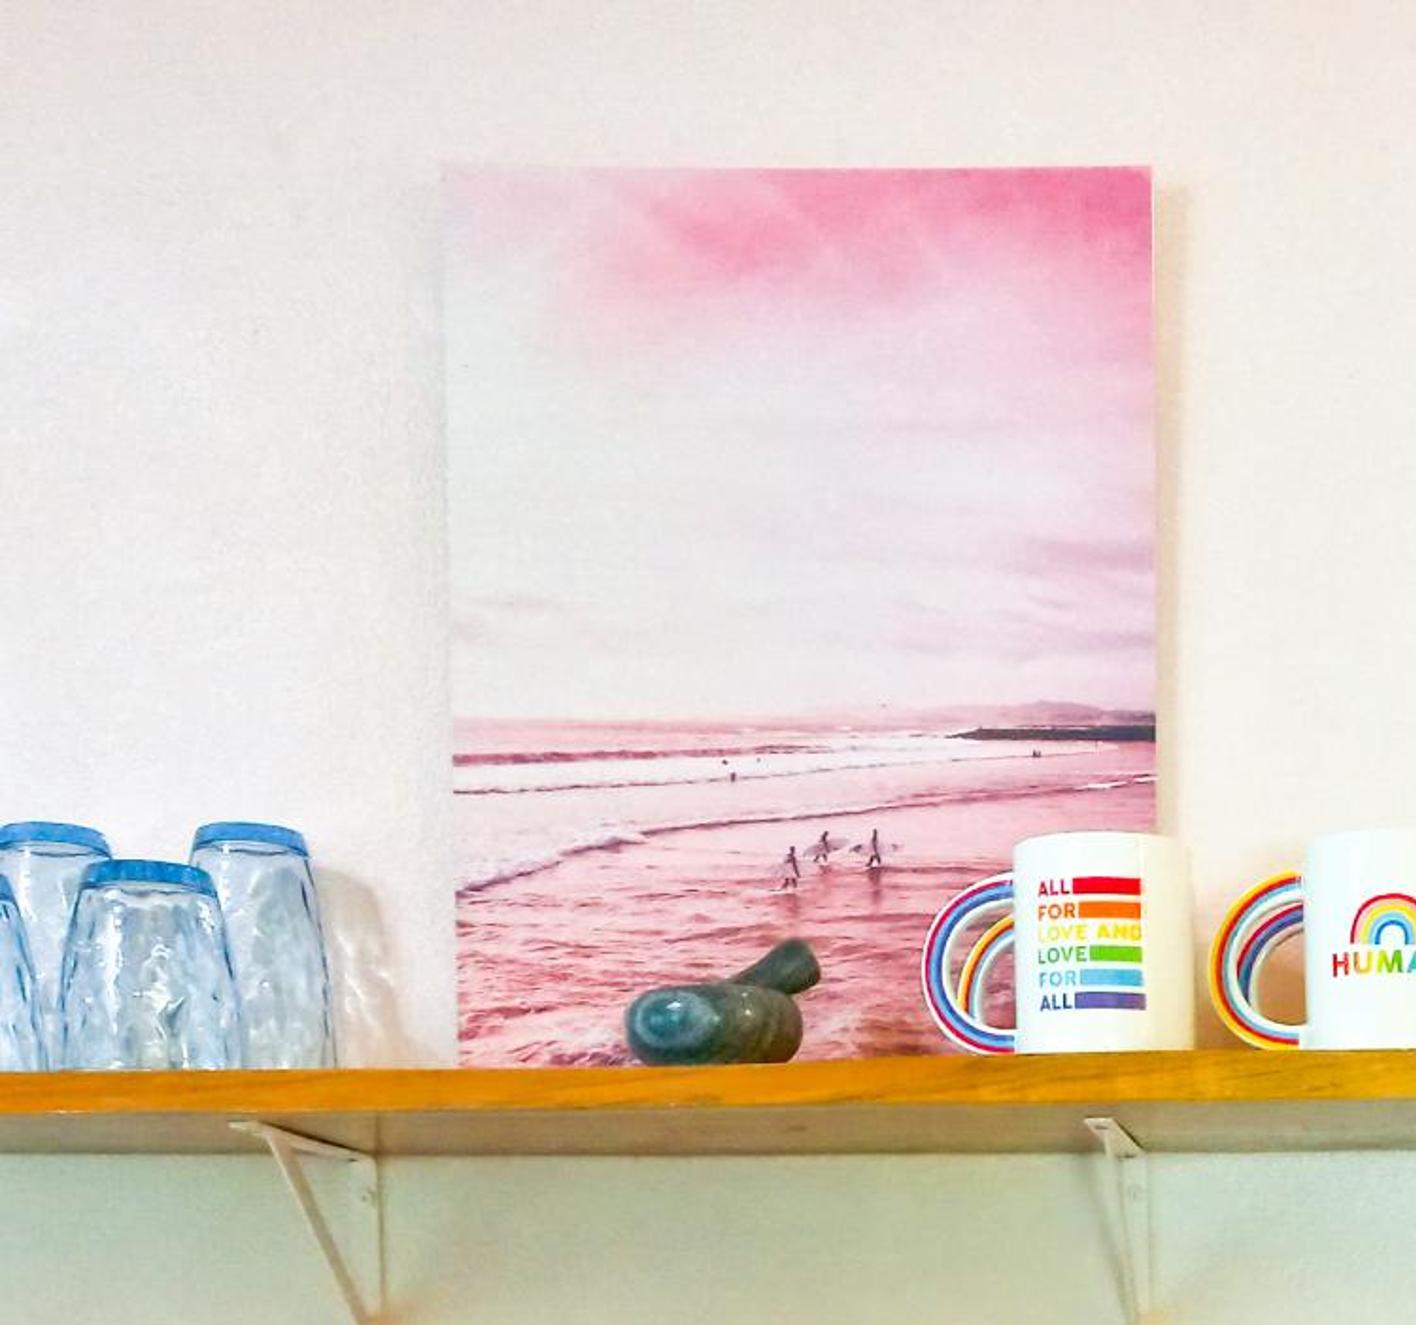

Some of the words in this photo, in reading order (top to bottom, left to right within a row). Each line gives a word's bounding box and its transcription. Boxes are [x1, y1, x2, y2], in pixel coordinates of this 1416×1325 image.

[1038, 878, 1070, 897] ALL
[1038, 902, 1076, 921] FOR
[1038, 923, 1087, 942] LOVE
[1097, 923, 1142, 941] AND
[1038, 945, 1087, 964] LOVE
[1039, 970, 1077, 989] FOR
[1040, 992, 1072, 1012] ALL
